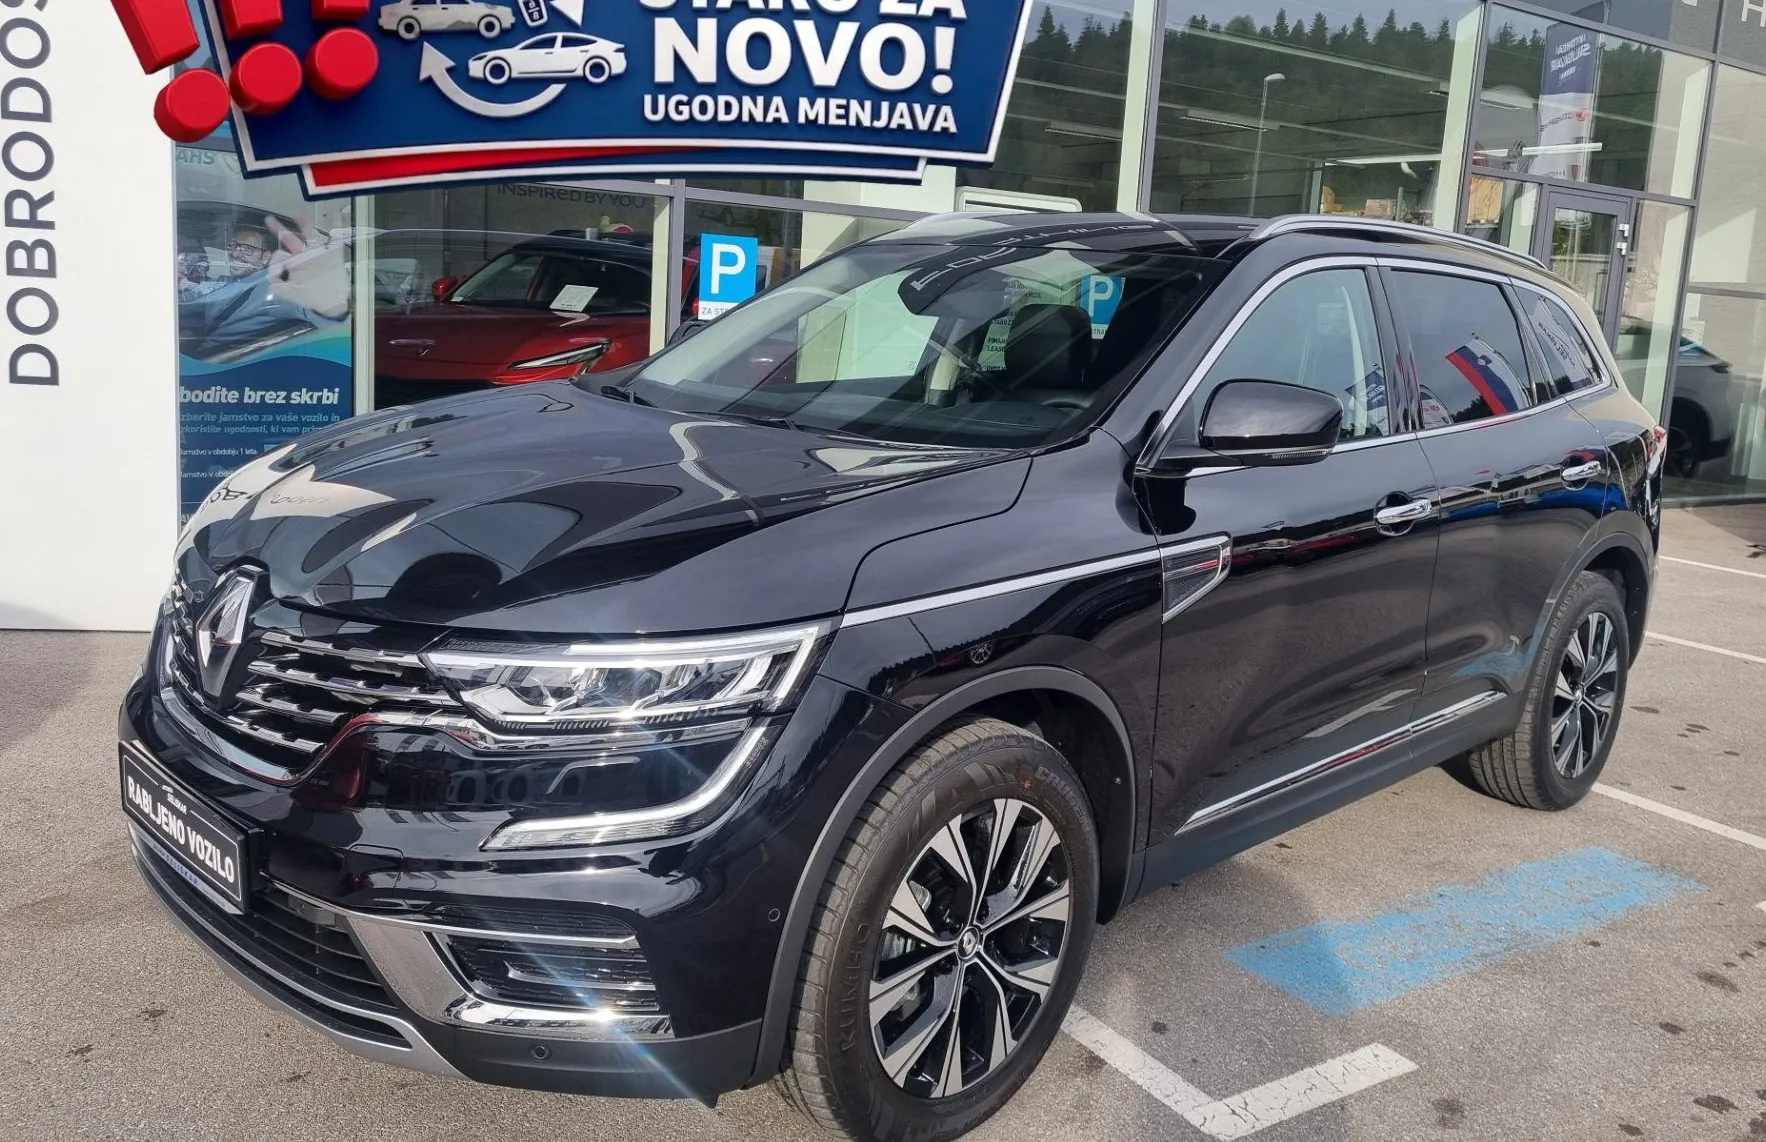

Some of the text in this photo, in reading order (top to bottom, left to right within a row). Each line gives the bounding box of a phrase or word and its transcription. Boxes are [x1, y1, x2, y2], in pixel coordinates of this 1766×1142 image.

[0, 0, 59, 386] DOBRODO
[585, 192, 606, 204] BY
[609, 194, 646, 208] YOU
[710, 243, 746, 294] P
[1088, 275, 1114, 317] P
[243, 386, 287, 404] brez
[290, 387, 340, 405] skrbi
[218, 412, 259, 423] jamstvo
[261, 414, 273, 422] za
[276, 411, 298, 422] vaše
[301, 412, 328, 422] vozilo
[330, 412, 340, 422] in
[127, 775, 235, 883] RABLJENO VOZILO
